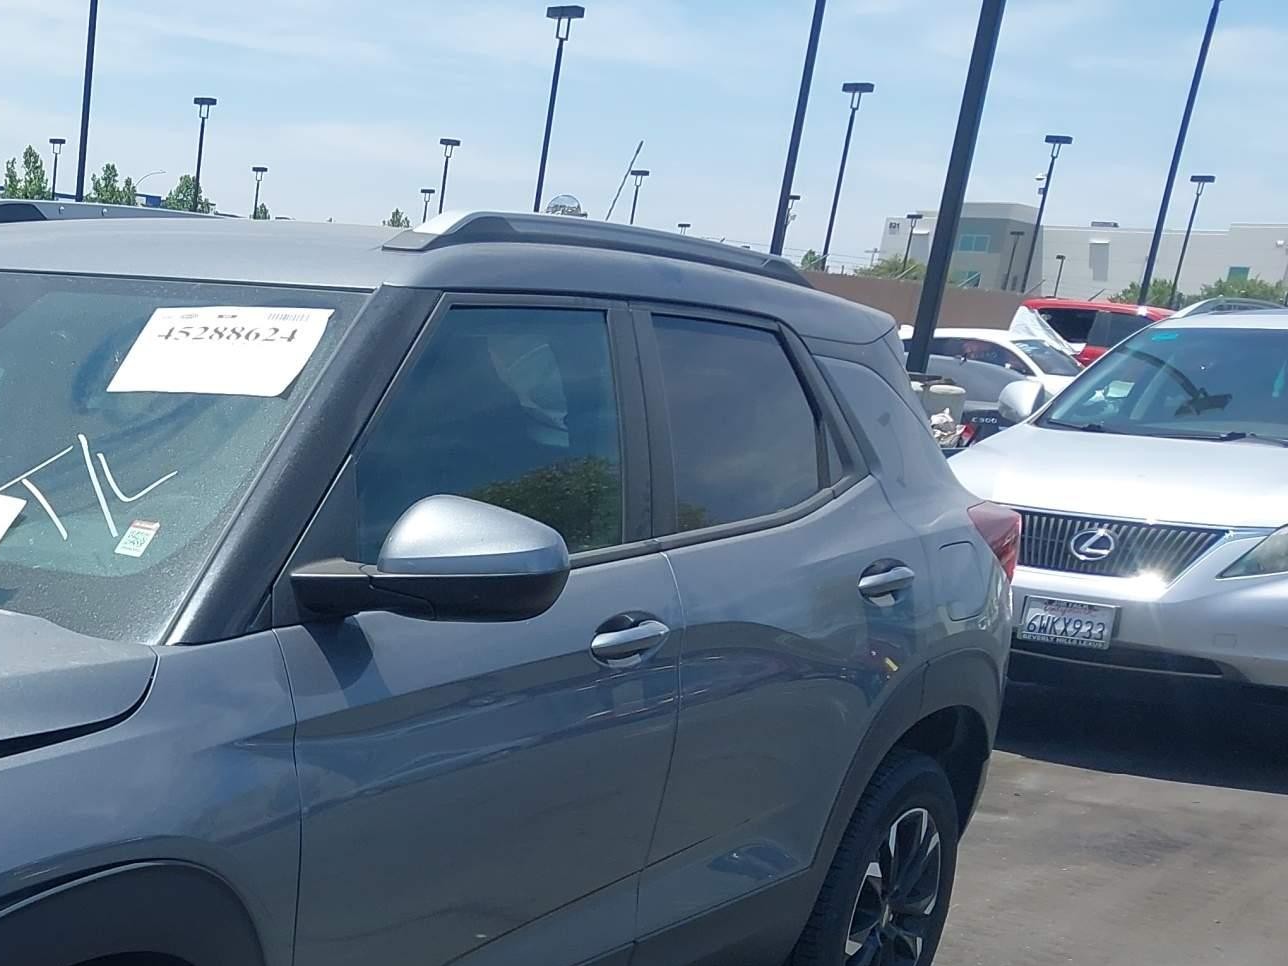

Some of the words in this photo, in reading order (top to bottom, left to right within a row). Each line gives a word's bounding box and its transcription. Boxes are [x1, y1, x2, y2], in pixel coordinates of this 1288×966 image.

[157, 325, 298, 342] 45288624
[1027, 613, 1106, 641] 6WKX933
[1022, 633, 1055, 642] BEVERLY
